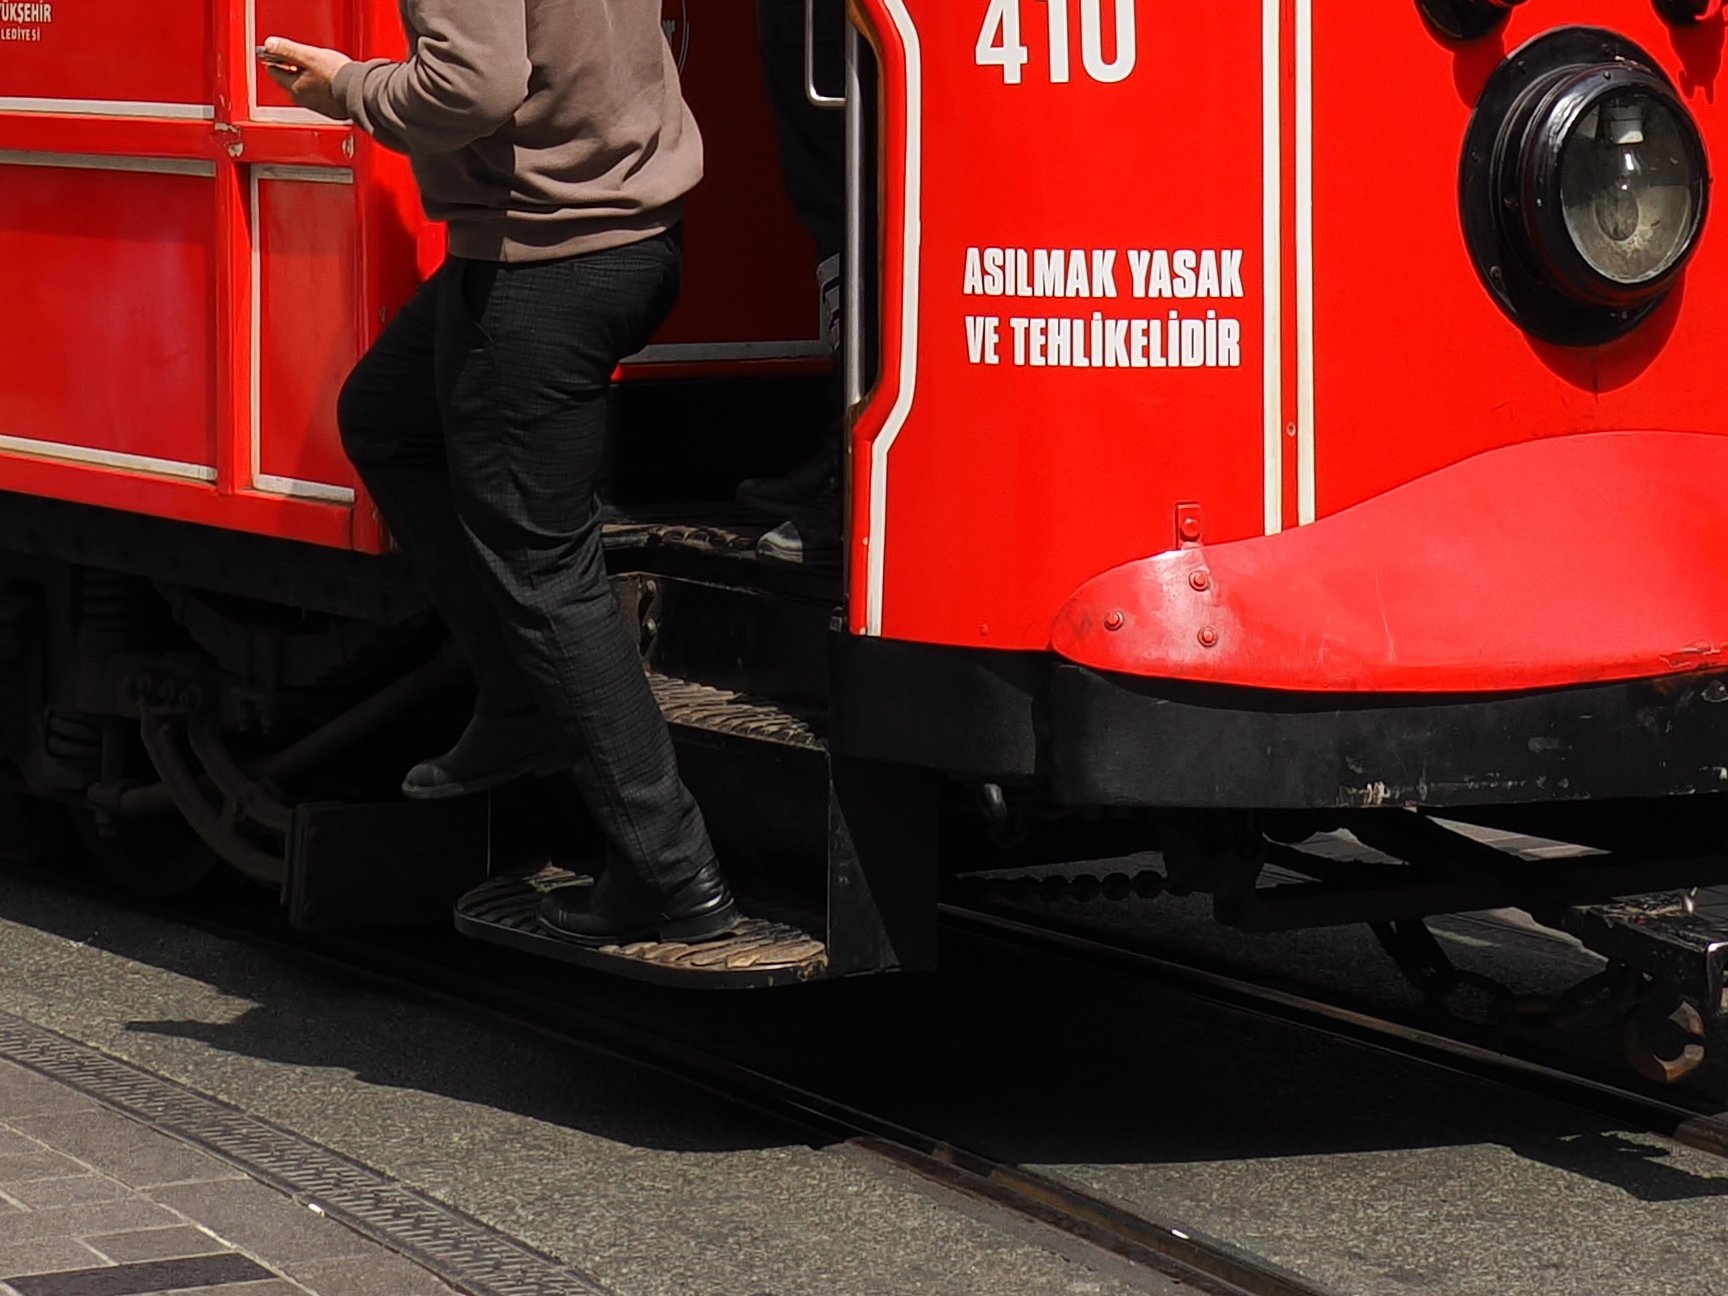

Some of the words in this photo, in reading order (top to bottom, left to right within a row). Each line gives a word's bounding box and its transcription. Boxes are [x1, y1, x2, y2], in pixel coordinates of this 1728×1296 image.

[962, 247, 1116, 299] ASILMAK
[1128, 247, 1244, 300] YASAK
[964, 316, 999, 366] VE
[1012, 308, 1241, 369] TEHLİKELİDİR
